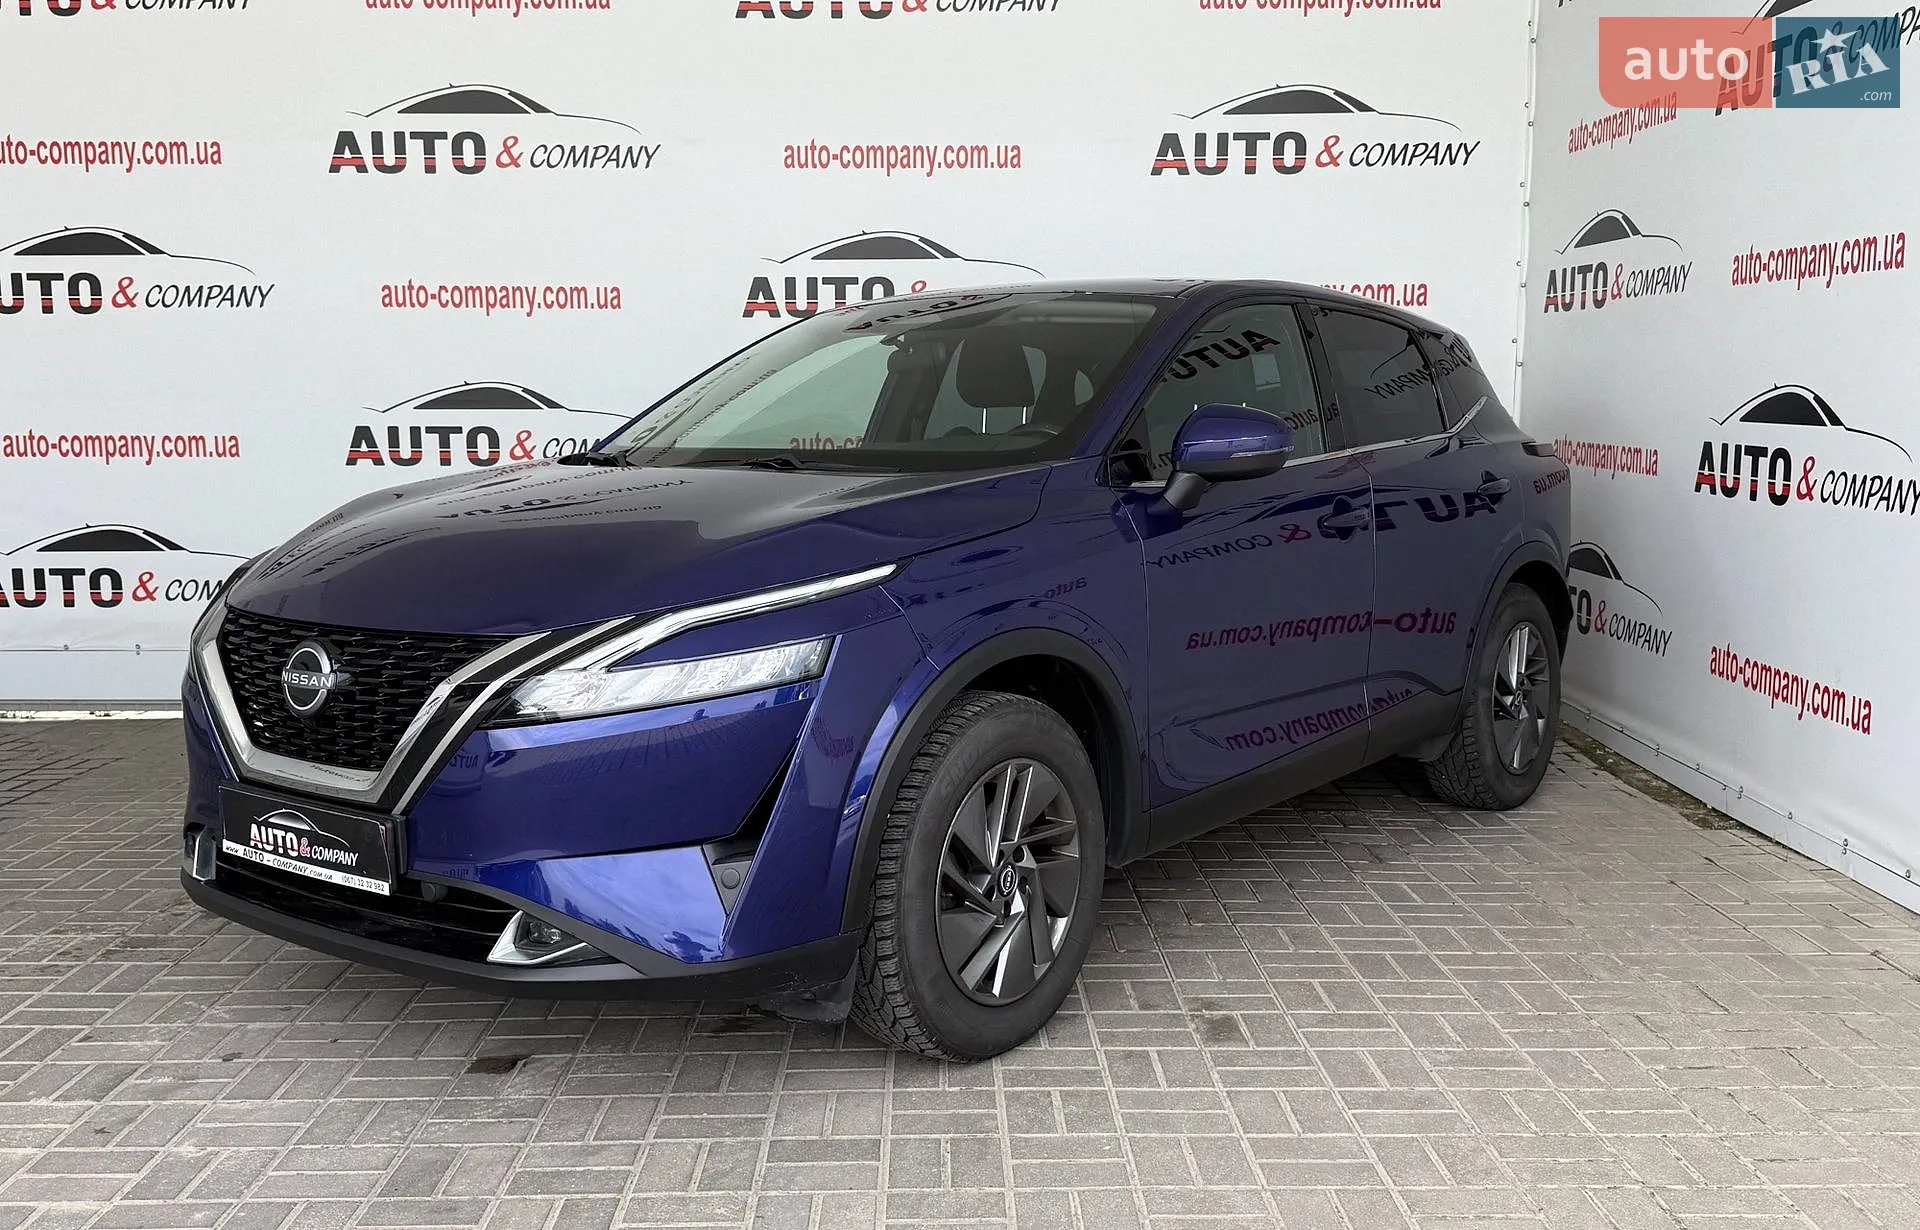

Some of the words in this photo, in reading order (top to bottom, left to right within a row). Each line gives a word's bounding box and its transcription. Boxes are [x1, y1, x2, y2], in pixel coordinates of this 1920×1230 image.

[1568, 91, 1678, 153] auto-company.com.ua
[0, 134, 222, 173] to-company.com.ua
[329, 131, 486, 175] AUTO
[495, 136, 523, 168] &
[530, 144, 661, 169] COMPANY
[784, 139, 1021, 177] auto-company.com.ua
[1151, 132, 1307, 175] AUTO
[1315, 135, 1344, 167] &
[1349, 141, 1480, 167] COMPANY
[1732, 233, 1905, 289] auto-company.com.ua
[0, 273, 102, 314] UTO
[112, 277, 139, 308] &
[145, 284, 275, 309] COMPANY
[382, 279, 621, 317] auto-company.com.ua
[1544, 262, 1608, 313] AUTO
[1611, 264, 1624, 298] &
[1626, 262, 1692, 298] COMPANY
[3, 429, 240, 465] auto-company.com.ua
[345, 426, 500, 467] AUTO
[509, 430, 536, 461] &
[1694, 441, 1793, 507] AUTO
[1796, 456, 1817, 501] &
[1820, 470, 1920, 516] COMPANY
[0, 568, 123, 608] UTO
[132, 572, 159, 601] &
[1609, 613, 1672, 657] COMPANY
[282, 670, 332, 688] NISSAN
[1710, 642, 1872, 736] auto-company.com.ua
[243, 848, 264, 862] AUTO
[250, 823, 298, 857] AUTO
[300, 837, 310, 857] &
[312, 846, 358, 866] COMPANY
